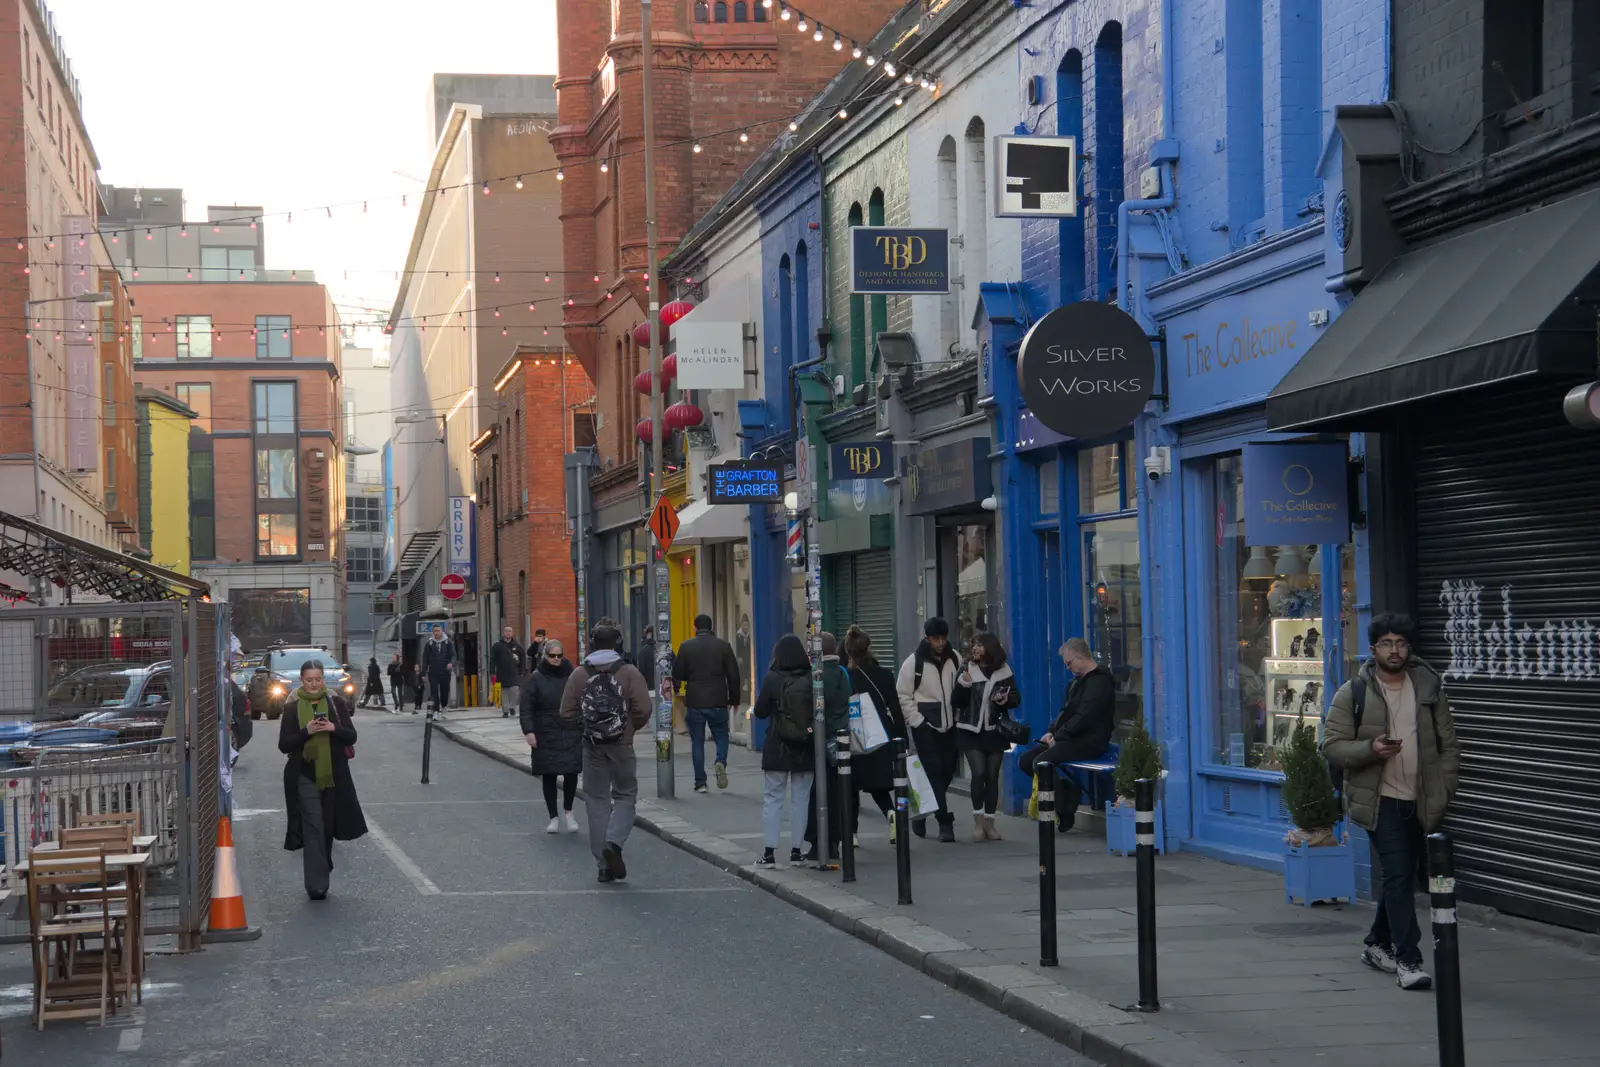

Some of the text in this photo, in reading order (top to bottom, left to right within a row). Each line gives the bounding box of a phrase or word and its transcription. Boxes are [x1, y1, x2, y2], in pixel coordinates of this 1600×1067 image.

[875, 235, 927, 271] TBD
[70, 220, 88, 340] BROOKS
[693, 347, 727, 355] HELEN
[1182, 311, 1297, 377] The Collective
[73, 358, 90, 470] HOTEL
[726, 469, 777, 481] GRAFTON
[843, 446, 881, 475] TBD
[715, 470, 725, 497] THE
[727, 483, 778, 497] BARBER
[1262, 499, 1338, 511] The Collective
[453, 498, 464, 557] DRURY
